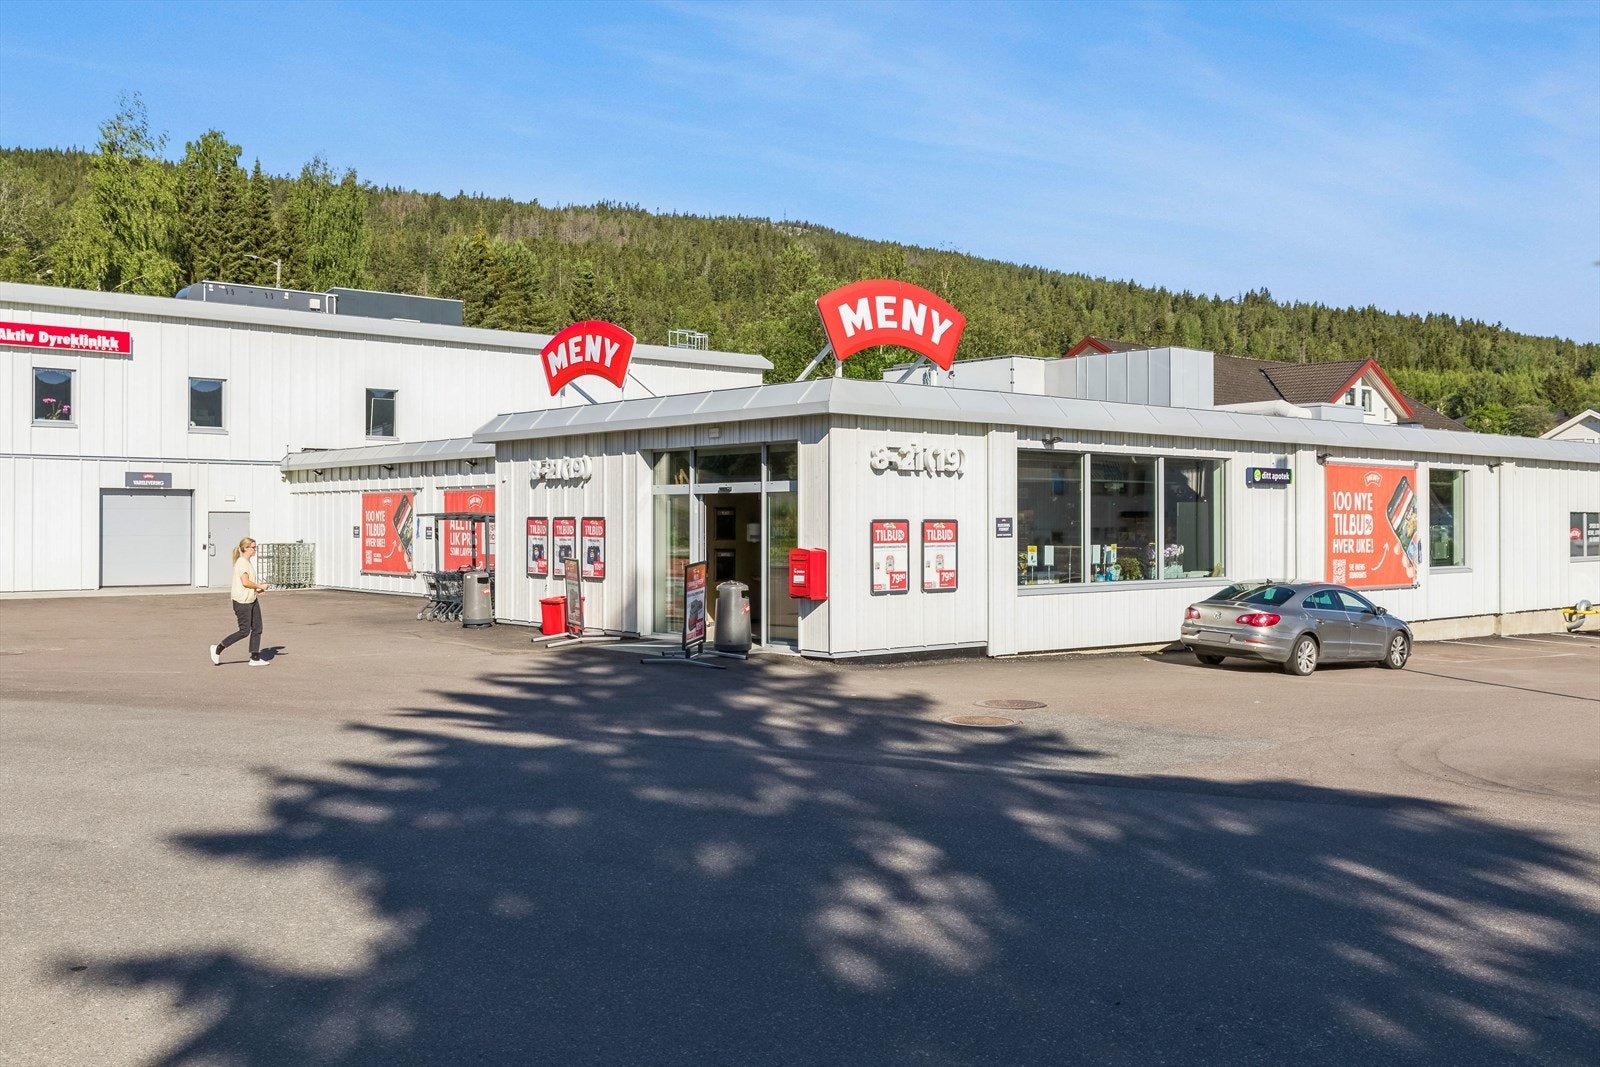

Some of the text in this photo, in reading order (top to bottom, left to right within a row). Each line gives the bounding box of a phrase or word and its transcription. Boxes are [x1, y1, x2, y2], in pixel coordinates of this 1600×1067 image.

[838, 295, 953, 345] MENY
[0, 327, 119, 349] Aktiv Dyreklinikk
[547, 334, 620, 378] MENY
[1261, 471, 1290, 482] ditt apotek
[1332, 491, 1373, 511] 100 NYE
[365, 510, 385, 522] 100 NYE
[366, 523, 386, 537] TILBUD
[530, 524, 546, 535] TILBUD
[556, 525, 574, 535] TILBUD
[585, 525, 603, 536] TILBUD
[1332, 513, 1374, 536] TILBUD
[450, 532, 460, 545] LIK
[875, 529, 905, 541] TILBUD
[926, 529, 954, 541] TILBUD
[365, 538, 376, 547] HVER
[1332, 538, 1374, 553] HVER UKE!
[450, 547, 459, 556] SOM
